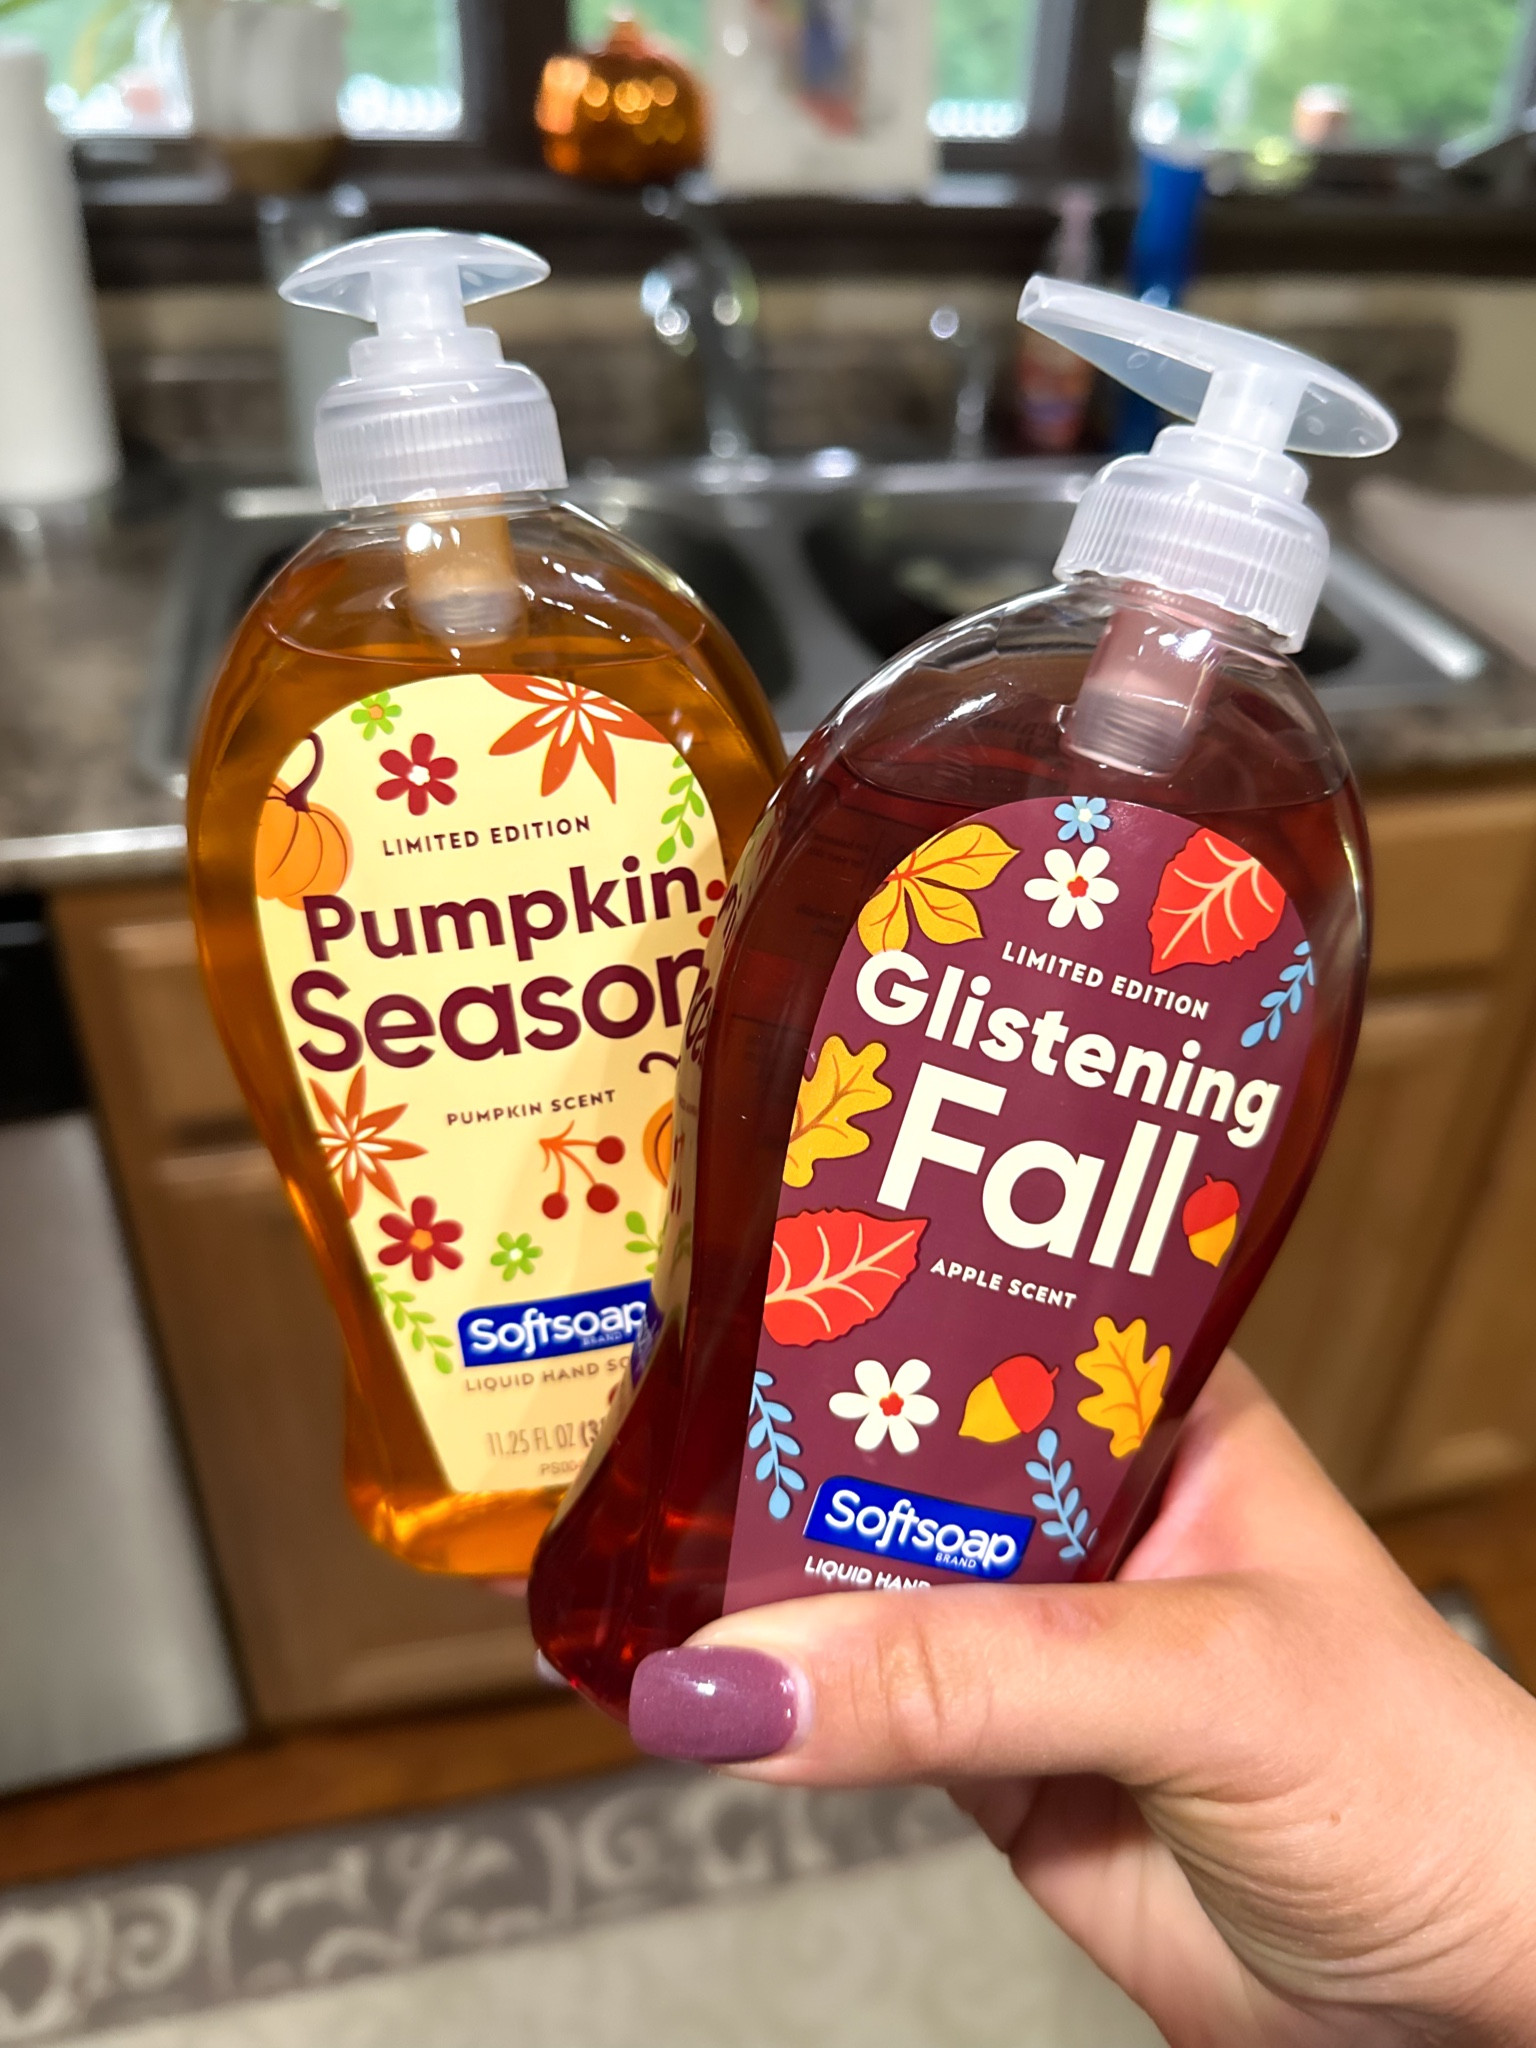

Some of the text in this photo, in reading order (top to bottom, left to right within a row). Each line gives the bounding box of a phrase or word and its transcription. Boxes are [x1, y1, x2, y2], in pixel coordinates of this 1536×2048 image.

[382, 814, 591, 857] LIMITED EDITION
[302, 854, 701, 962] Pumpkin
[1001, 941, 1210, 1020] LIMITED EDITION
[855, 949, 1281, 1149] Glistening
[446, 1089, 616, 1126] PUMPKIN SCENT
[876, 1061, 1200, 1277] Fall
[930, 1257, 1077, 1310] APPLE SCENT
[468, 1300, 647, 1356] Softsoap
[465, 1372, 535, 1393] LIQUID
[543, 1362, 600, 1382] HAND
[486, 1428, 530, 1455] 11.25
[534, 1426, 552, 1451] FL
[555, 1422, 576, 1449] OZ
[824, 1489, 1016, 1567] Softsoap
[804, 1555, 873, 1584] LIQUID
[935, 1552, 977, 1569] BRAND
